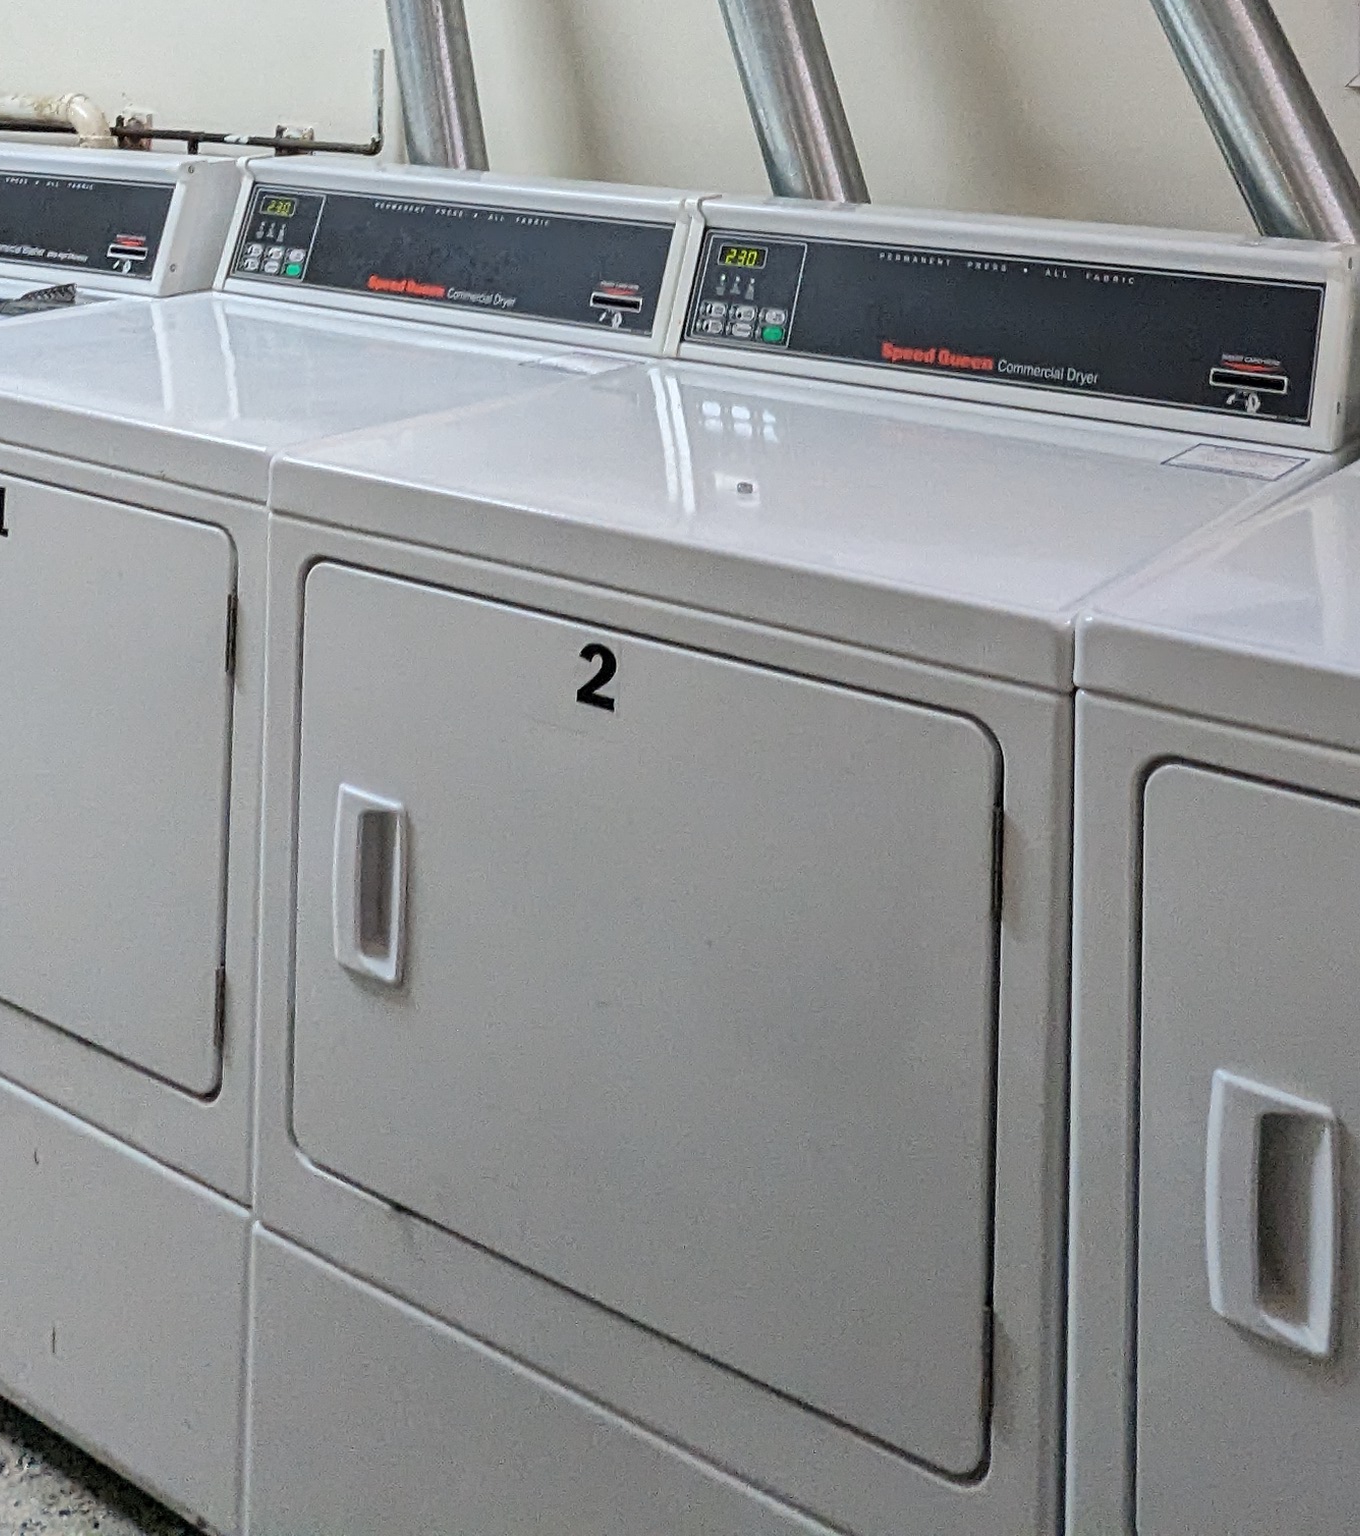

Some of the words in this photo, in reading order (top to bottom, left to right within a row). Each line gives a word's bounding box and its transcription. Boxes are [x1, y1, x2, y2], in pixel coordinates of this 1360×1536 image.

[879, 252, 952, 266] PERMANENT
[1045, 268, 1068, 279] ALL
[492, 292, 517, 308] Dryer
[997, 359, 1065, 381] Commercial
[1066, 367, 1099, 386] Dryer
[576, 643, 617, 713] 2
